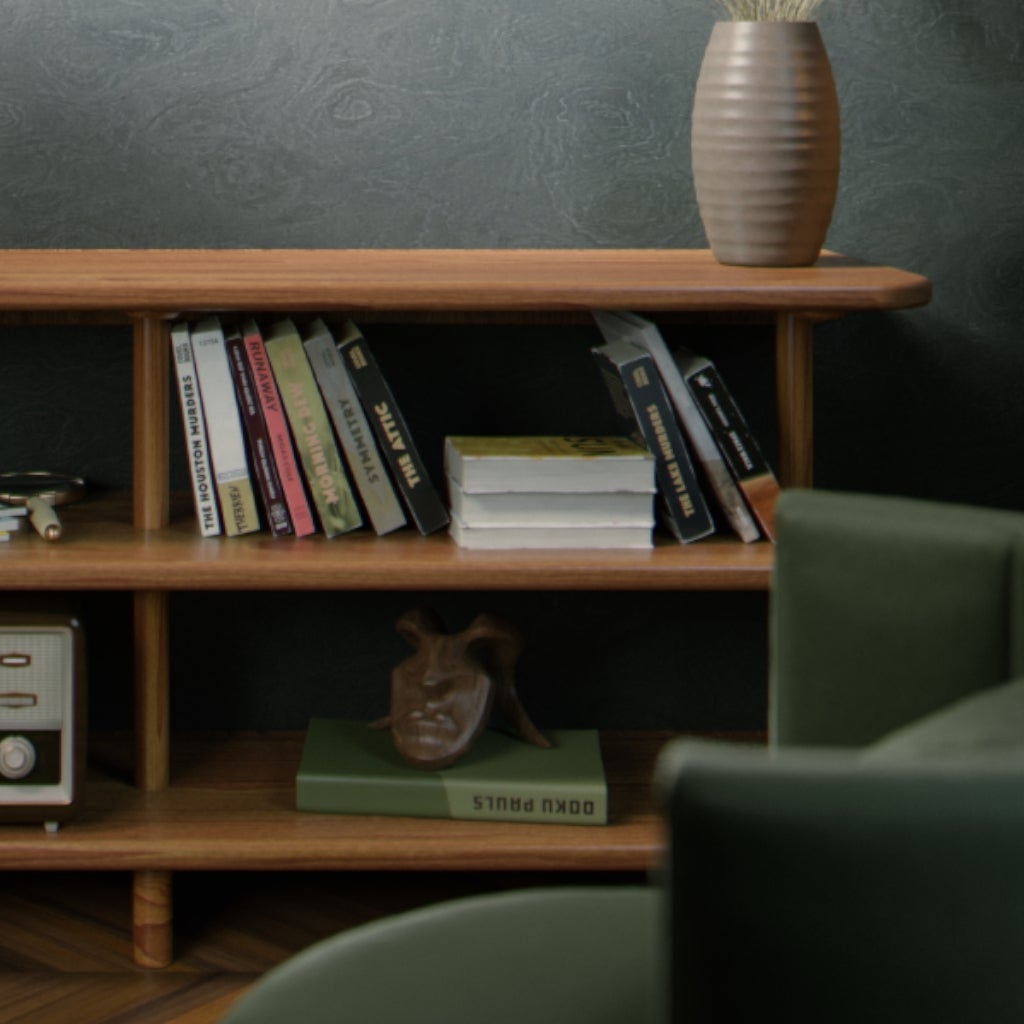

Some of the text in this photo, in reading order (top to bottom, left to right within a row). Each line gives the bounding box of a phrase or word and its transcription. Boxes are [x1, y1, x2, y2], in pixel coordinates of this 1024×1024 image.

[181, 374, 202, 436] MURDERS
[249, 341, 278, 413] RUNAWAY
[289, 381, 311, 419] DEW
[192, 436, 211, 503] HOUSTON
[303, 419, 342, 506] MORNING
[337, 397, 380, 485] SYMMETRY
[374, 401, 421, 490] THE ATTIC
[646, 404, 696, 519] THE LAKE MURDERS
[202, 506, 215, 530] THE
[473, 795, 595, 815] DOKU PAULS
